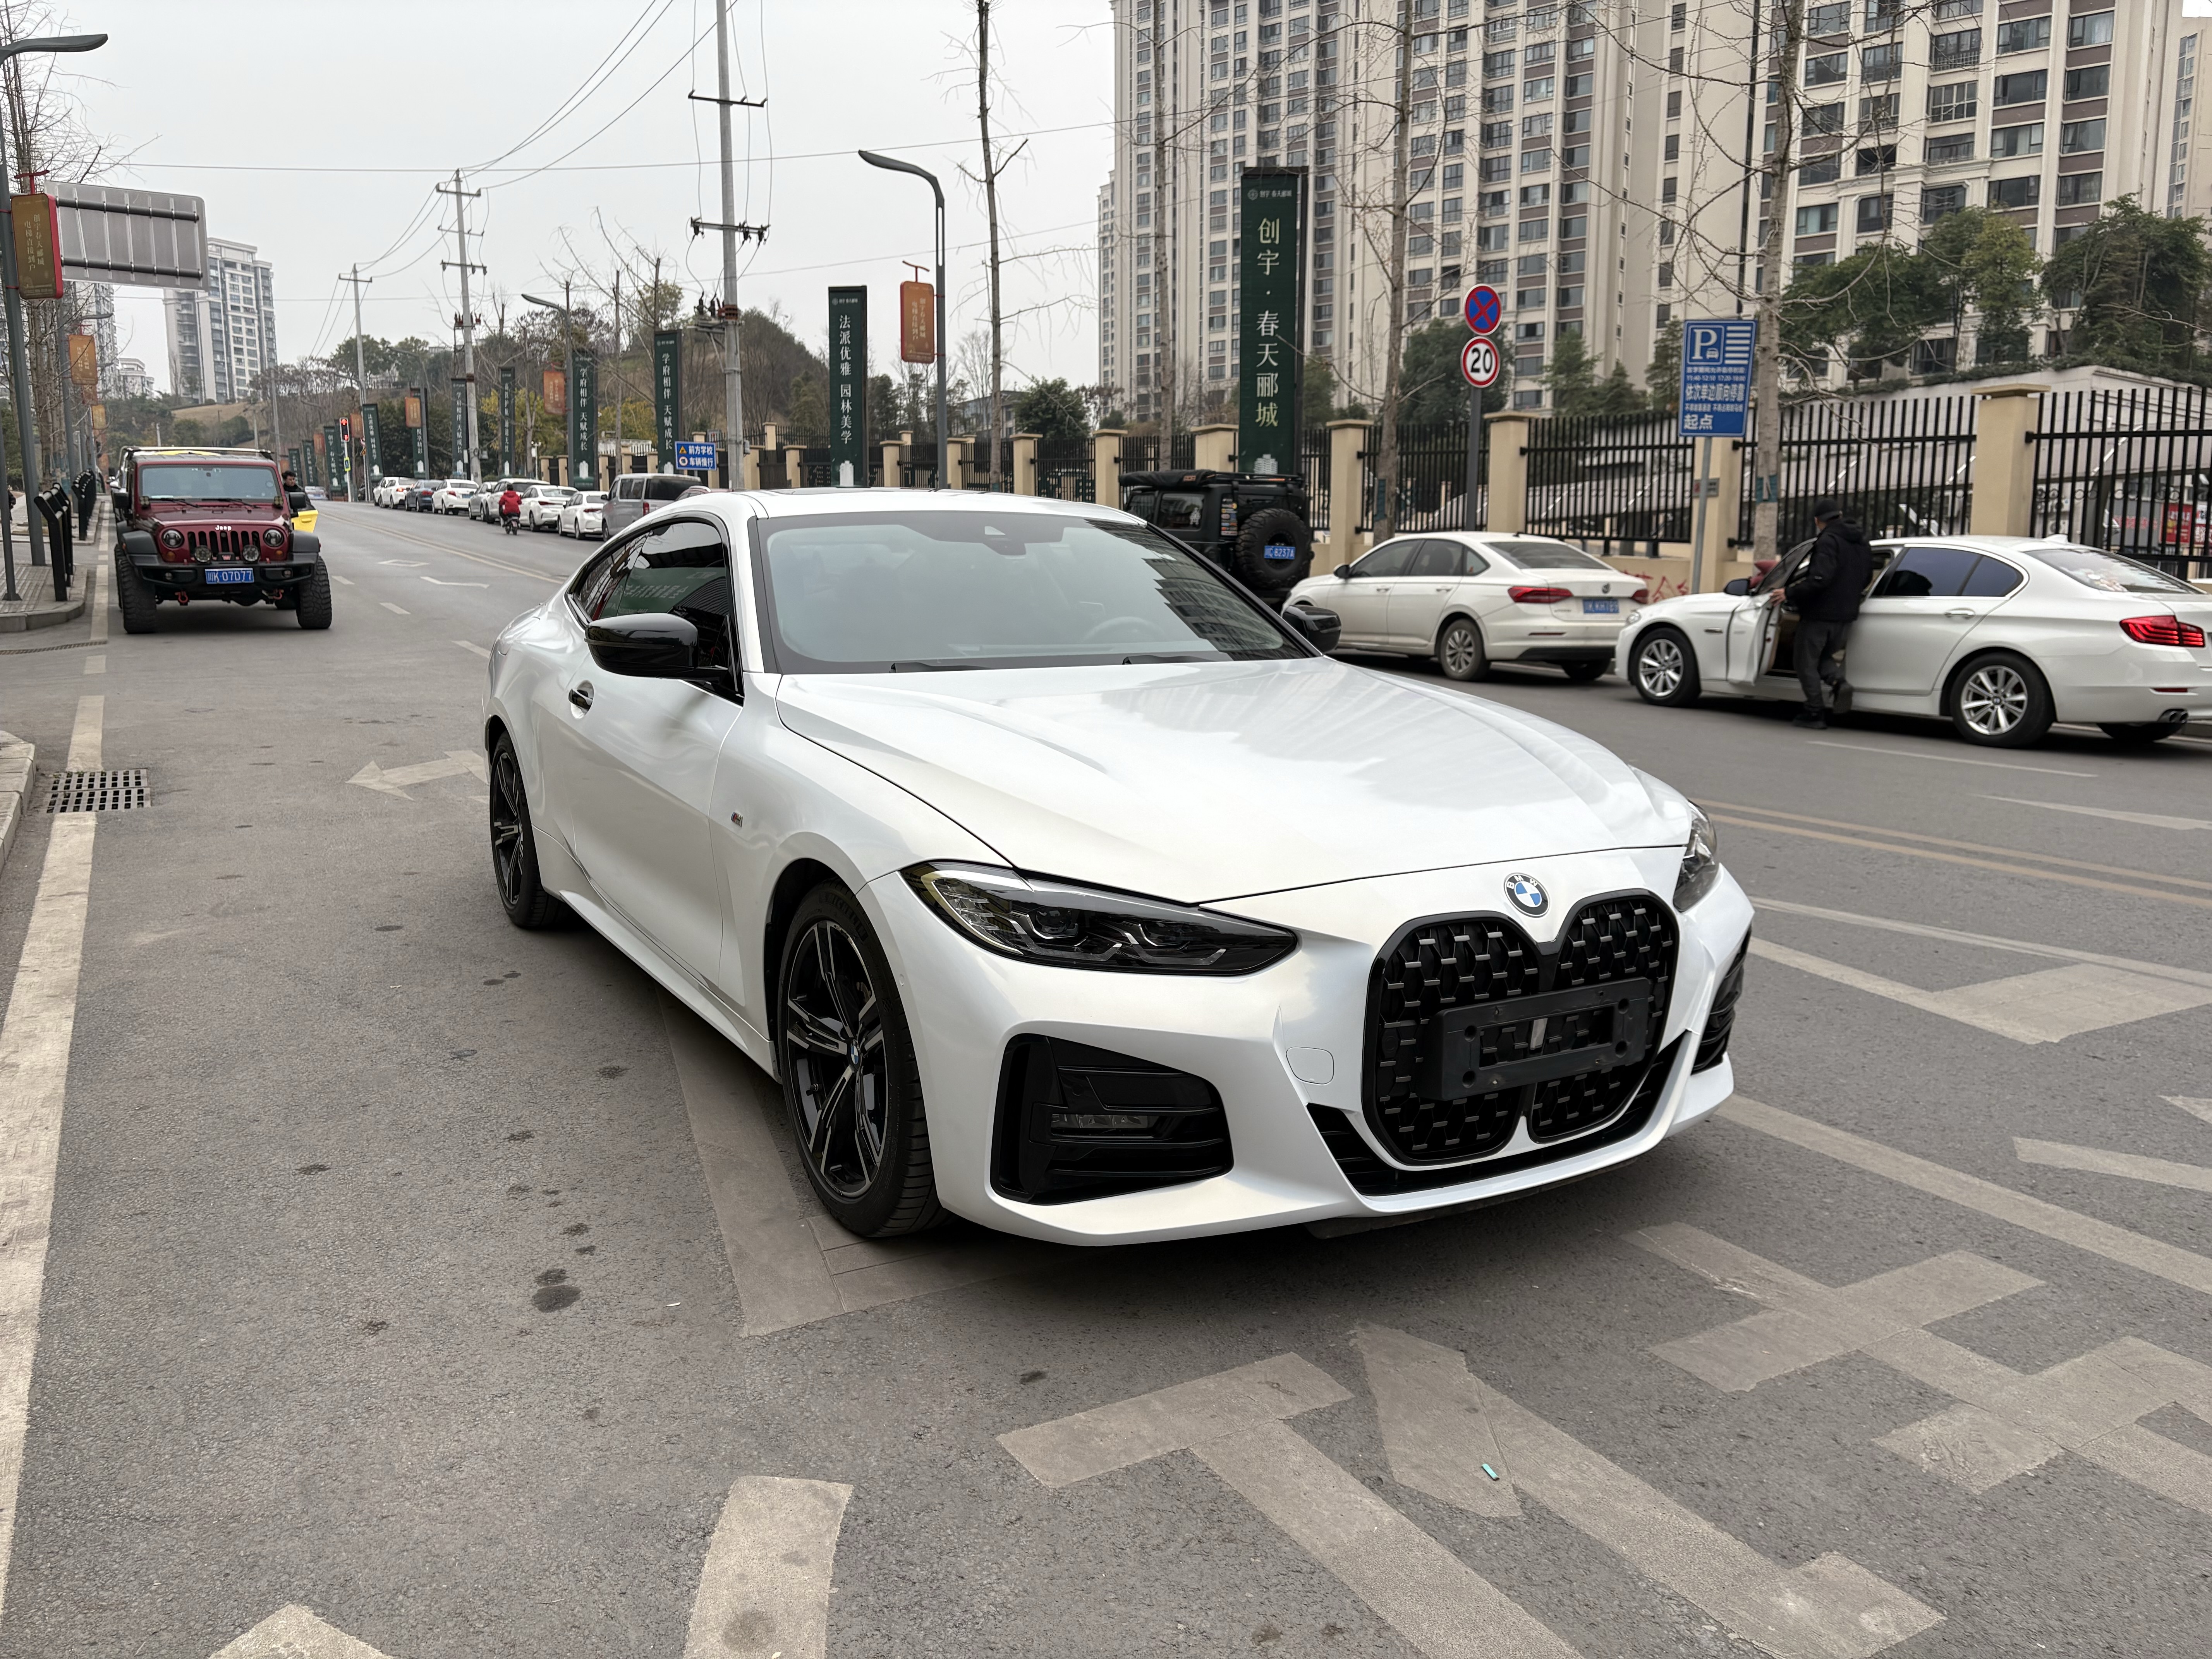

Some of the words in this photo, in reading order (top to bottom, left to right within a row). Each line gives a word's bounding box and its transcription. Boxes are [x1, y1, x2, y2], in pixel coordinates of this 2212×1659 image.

[1255, 217, 1280, 427] 创宇·春天郦城
[839, 315, 851, 376] 法派优雅
[1692, 329, 1717, 360] P
[662, 353, 672, 399] 学府相伴
[1471, 347, 1492, 374] 20
[664, 405, 673, 450] 天赋成长
[840, 384, 852, 444] 园林美学
[1683, 414, 1714, 430] 起点
[689, 445, 713, 455] 前方学校
[689, 457, 713, 467] 车辆慢行
[1507, 875, 1538, 889] BMW
